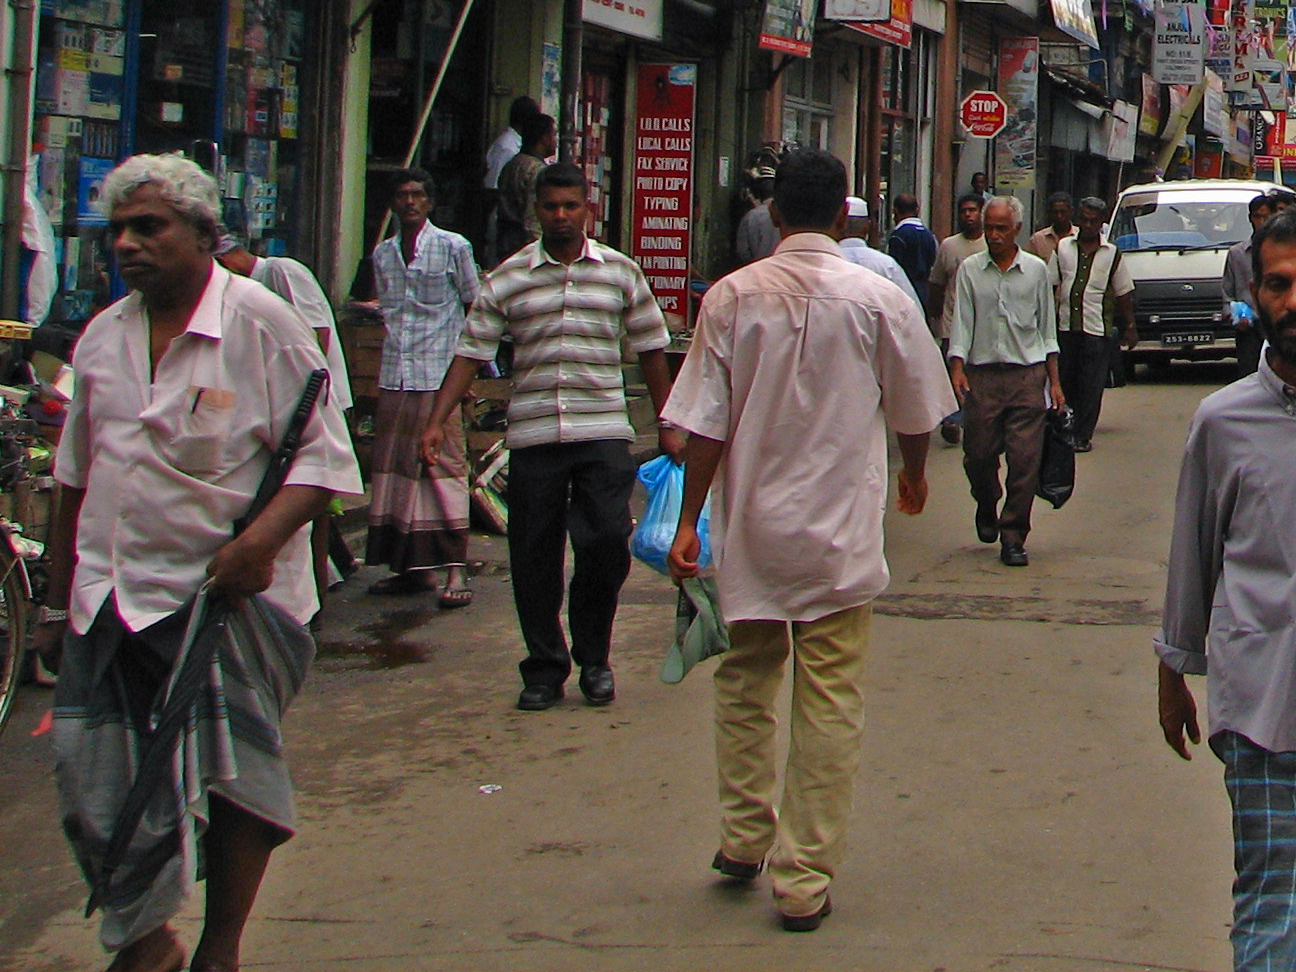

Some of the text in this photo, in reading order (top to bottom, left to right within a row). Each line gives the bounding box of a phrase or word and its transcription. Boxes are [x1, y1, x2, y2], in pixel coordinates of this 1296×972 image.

[970, 99, 999, 113] STOP
[662, 117, 691, 132] CALLS
[638, 136, 691, 151] LOCAL CALLS
[637, 156, 689, 171] FAX SERVICE
[636, 176, 688, 191] PHOTO COPY
[644, 196, 679, 211] TYPING
[640, 236, 682, 251] BINDING
[653, 256, 687, 270] PRINTING
